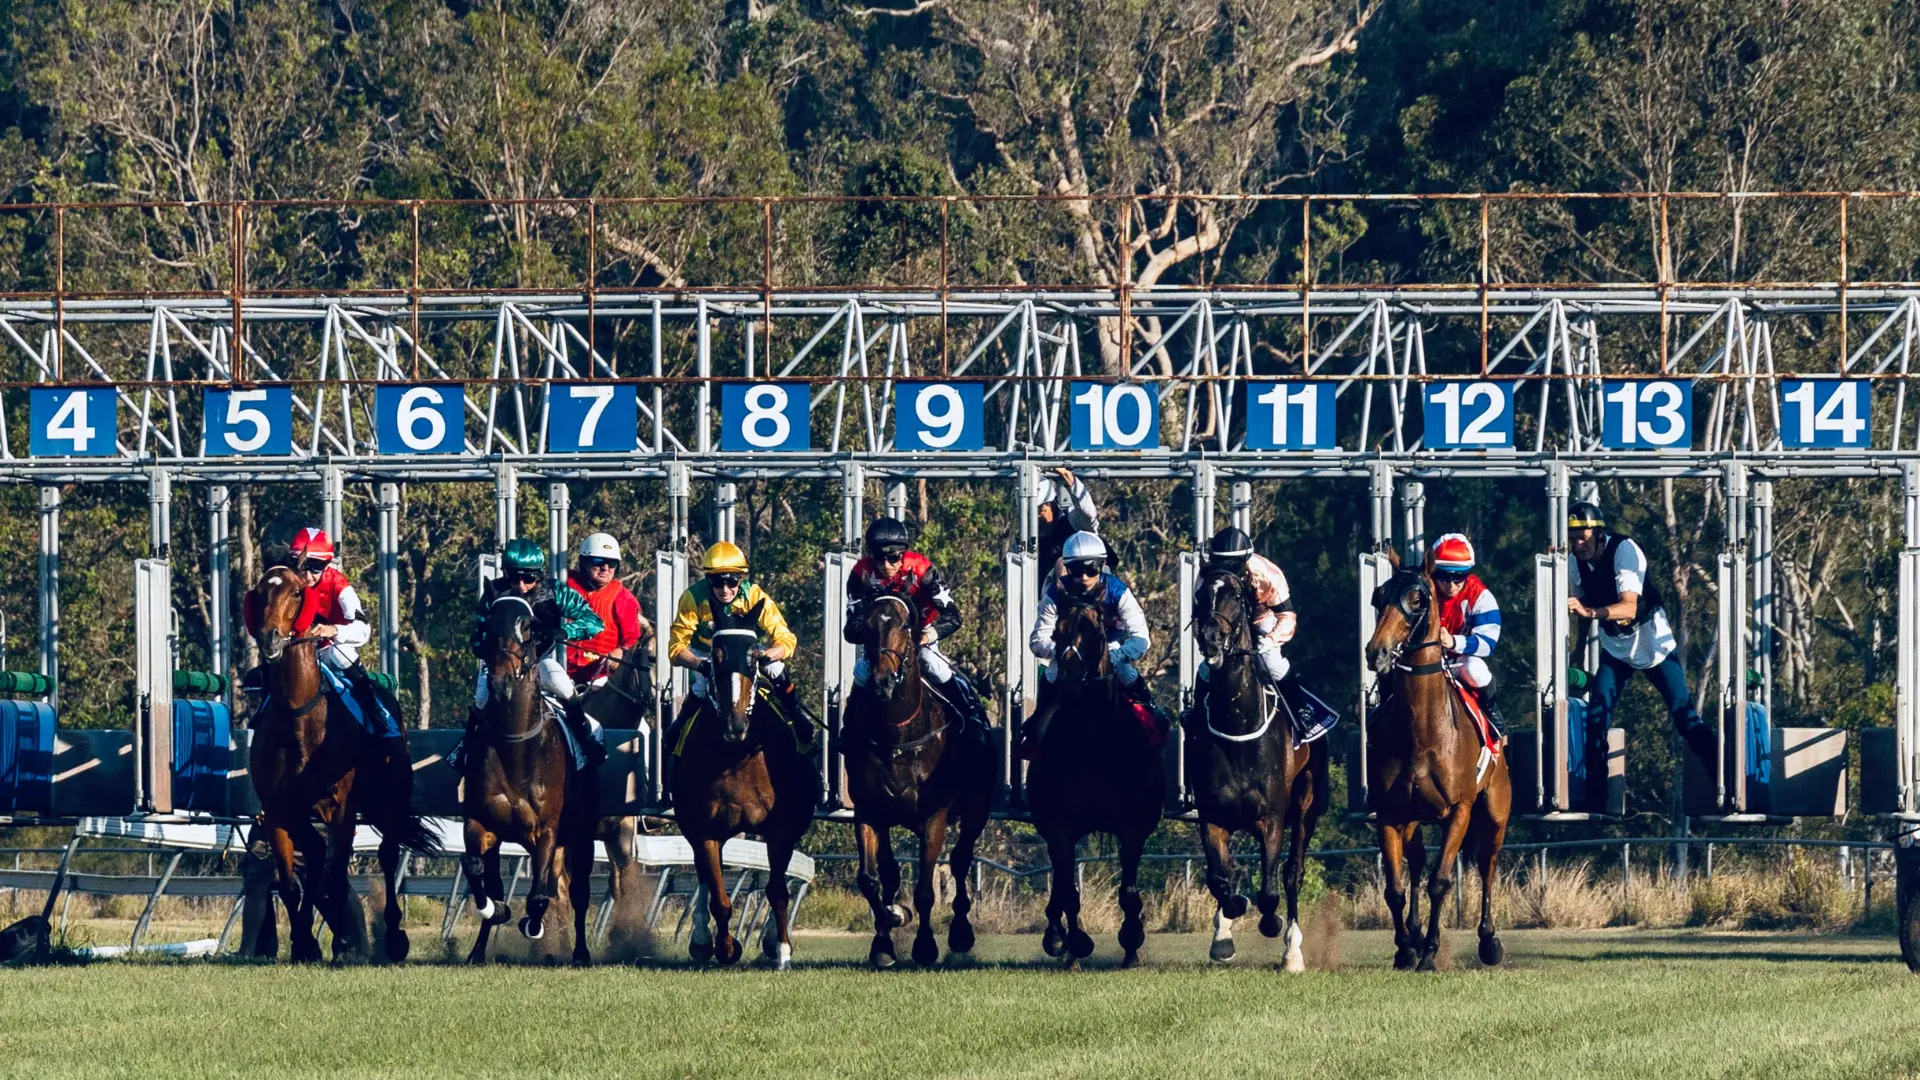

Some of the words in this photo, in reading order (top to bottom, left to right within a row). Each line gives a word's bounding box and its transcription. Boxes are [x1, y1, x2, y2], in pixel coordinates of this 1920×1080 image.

[47, 392, 96, 451] 4
[224, 390, 271, 452] 5
[397, 387, 446, 450] 6
[570, 386, 615, 447] 7
[741, 385, 791, 447] 8
[915, 384, 964, 447] 9
[1075, 383, 1152, 446] 10
[1258, 384, 1318, 445] 11
[1430, 382, 1506, 444] 12
[1607, 382, 1686, 444] 13
[1784, 382, 1865, 443] 14
